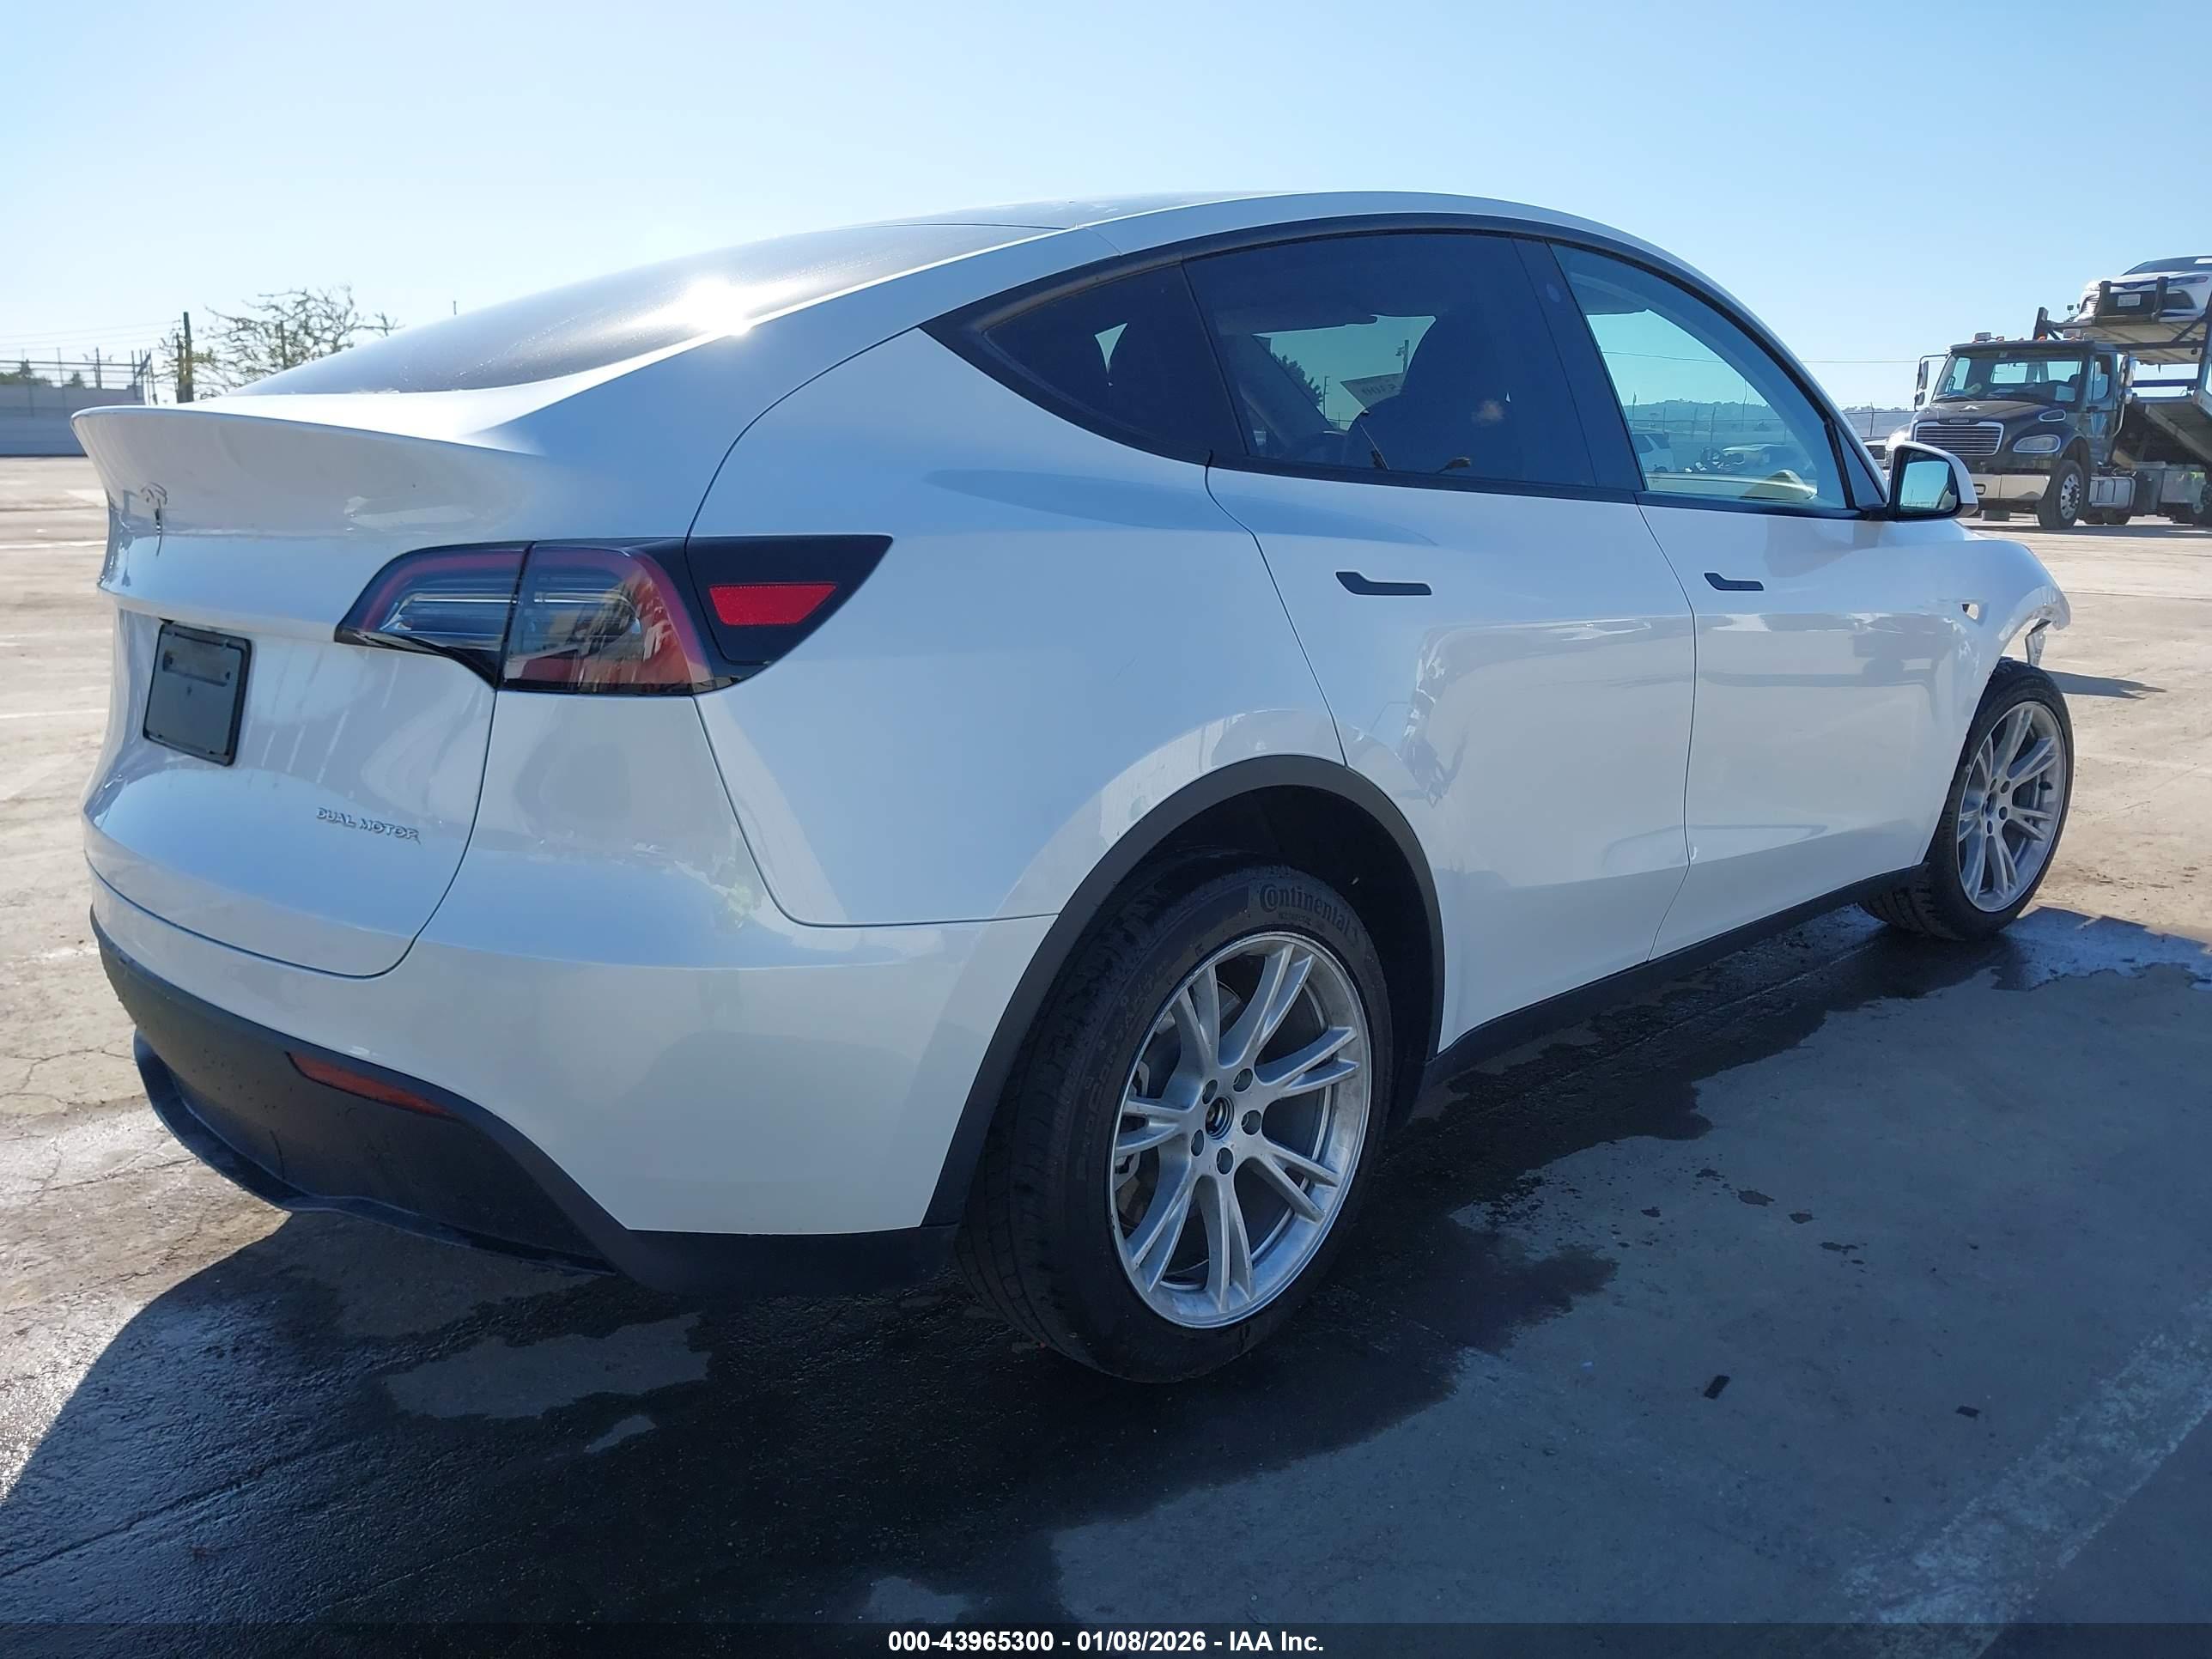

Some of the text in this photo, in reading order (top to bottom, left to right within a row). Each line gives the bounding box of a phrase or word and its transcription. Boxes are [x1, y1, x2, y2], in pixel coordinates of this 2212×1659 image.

[317, 807, 421, 845] DUAL MOTOR
[1260, 884, 1351, 934] Continental
